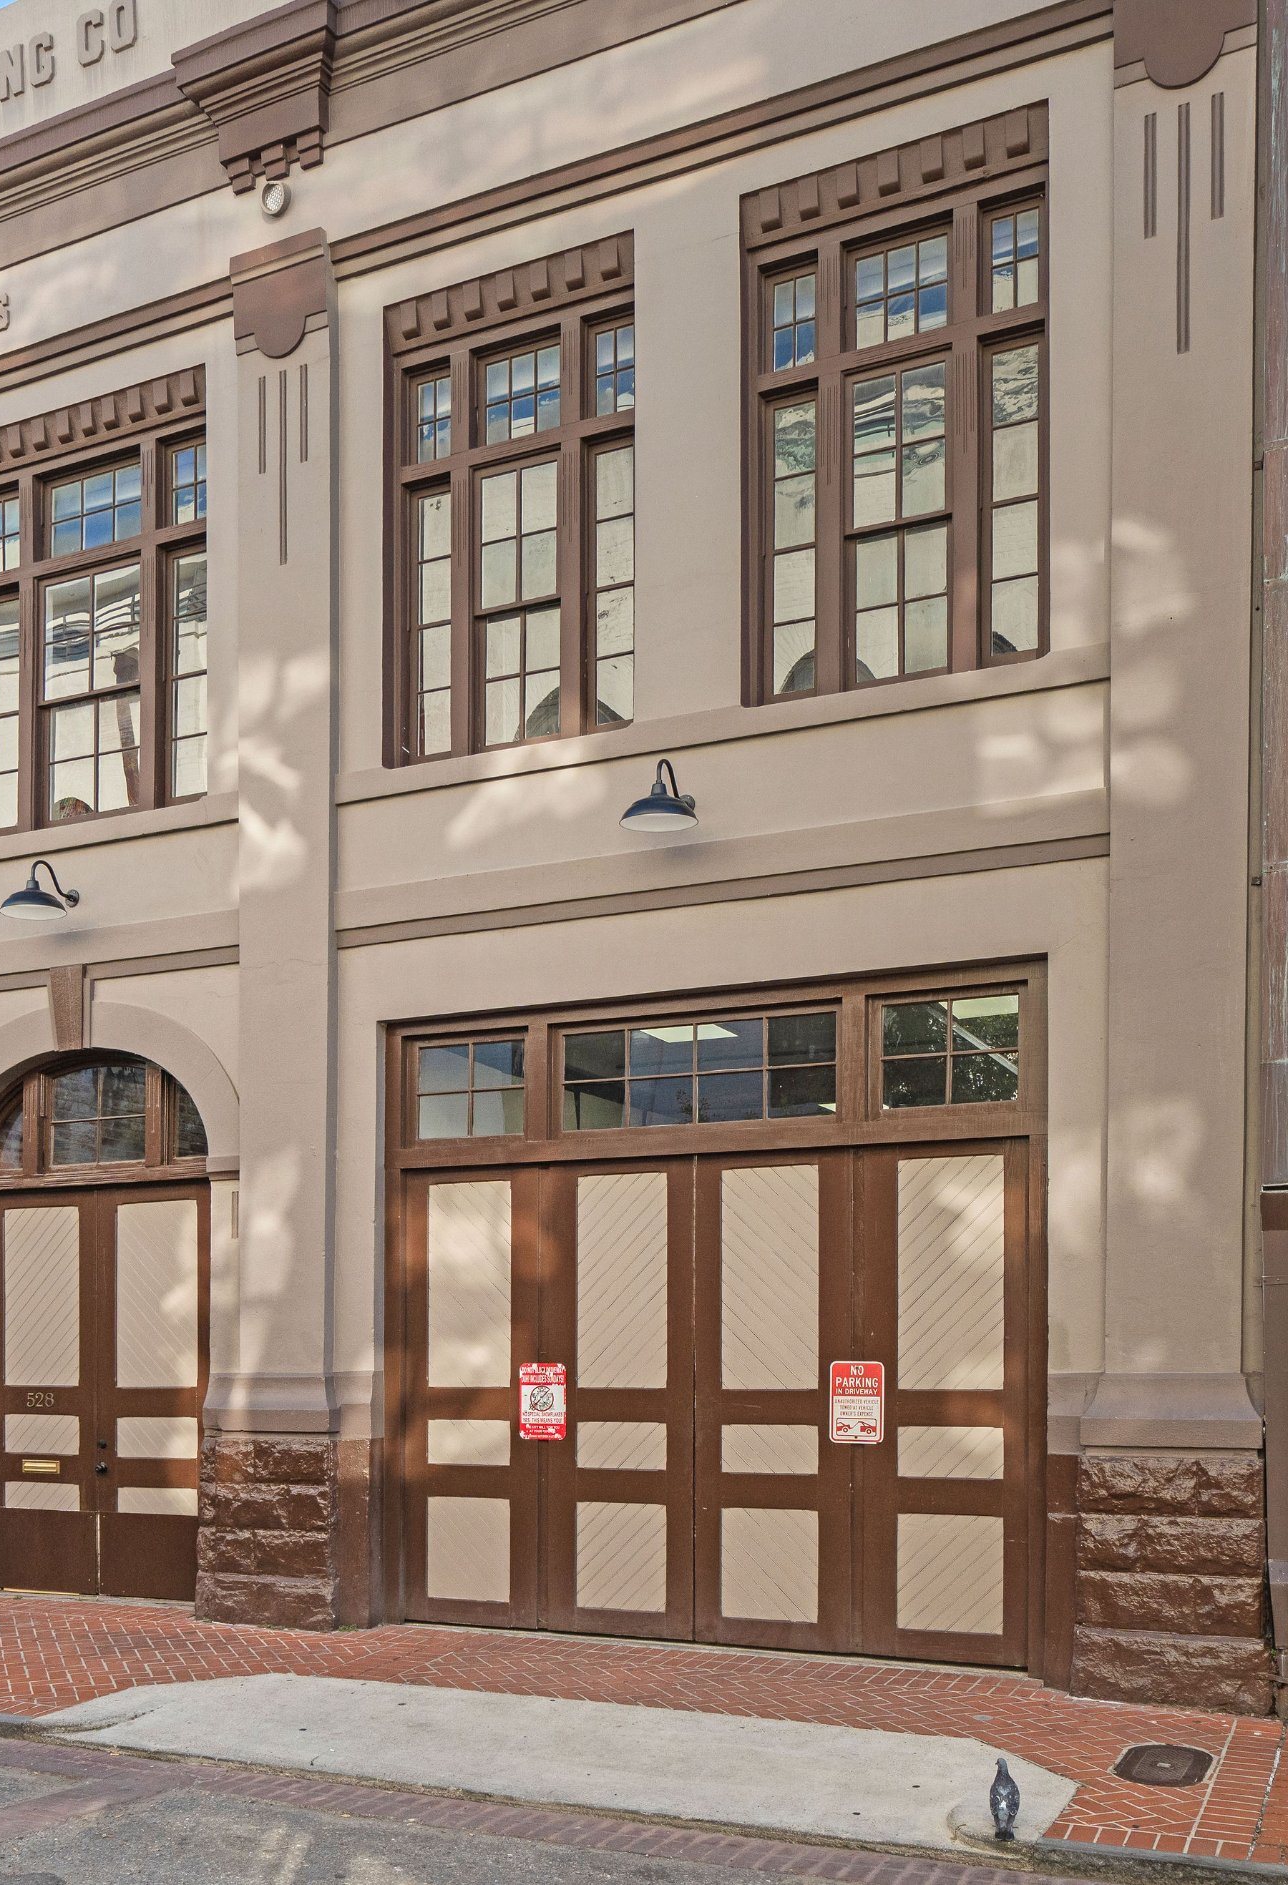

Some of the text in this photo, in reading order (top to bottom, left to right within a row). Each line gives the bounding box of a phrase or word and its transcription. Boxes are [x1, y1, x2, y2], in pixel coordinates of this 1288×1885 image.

[76, 0, 138, 68] CO
[850, 1365, 865, 1376] NO
[835, 1376, 879, 1388] PARKING
[26, 1391, 55, 1408] 528
